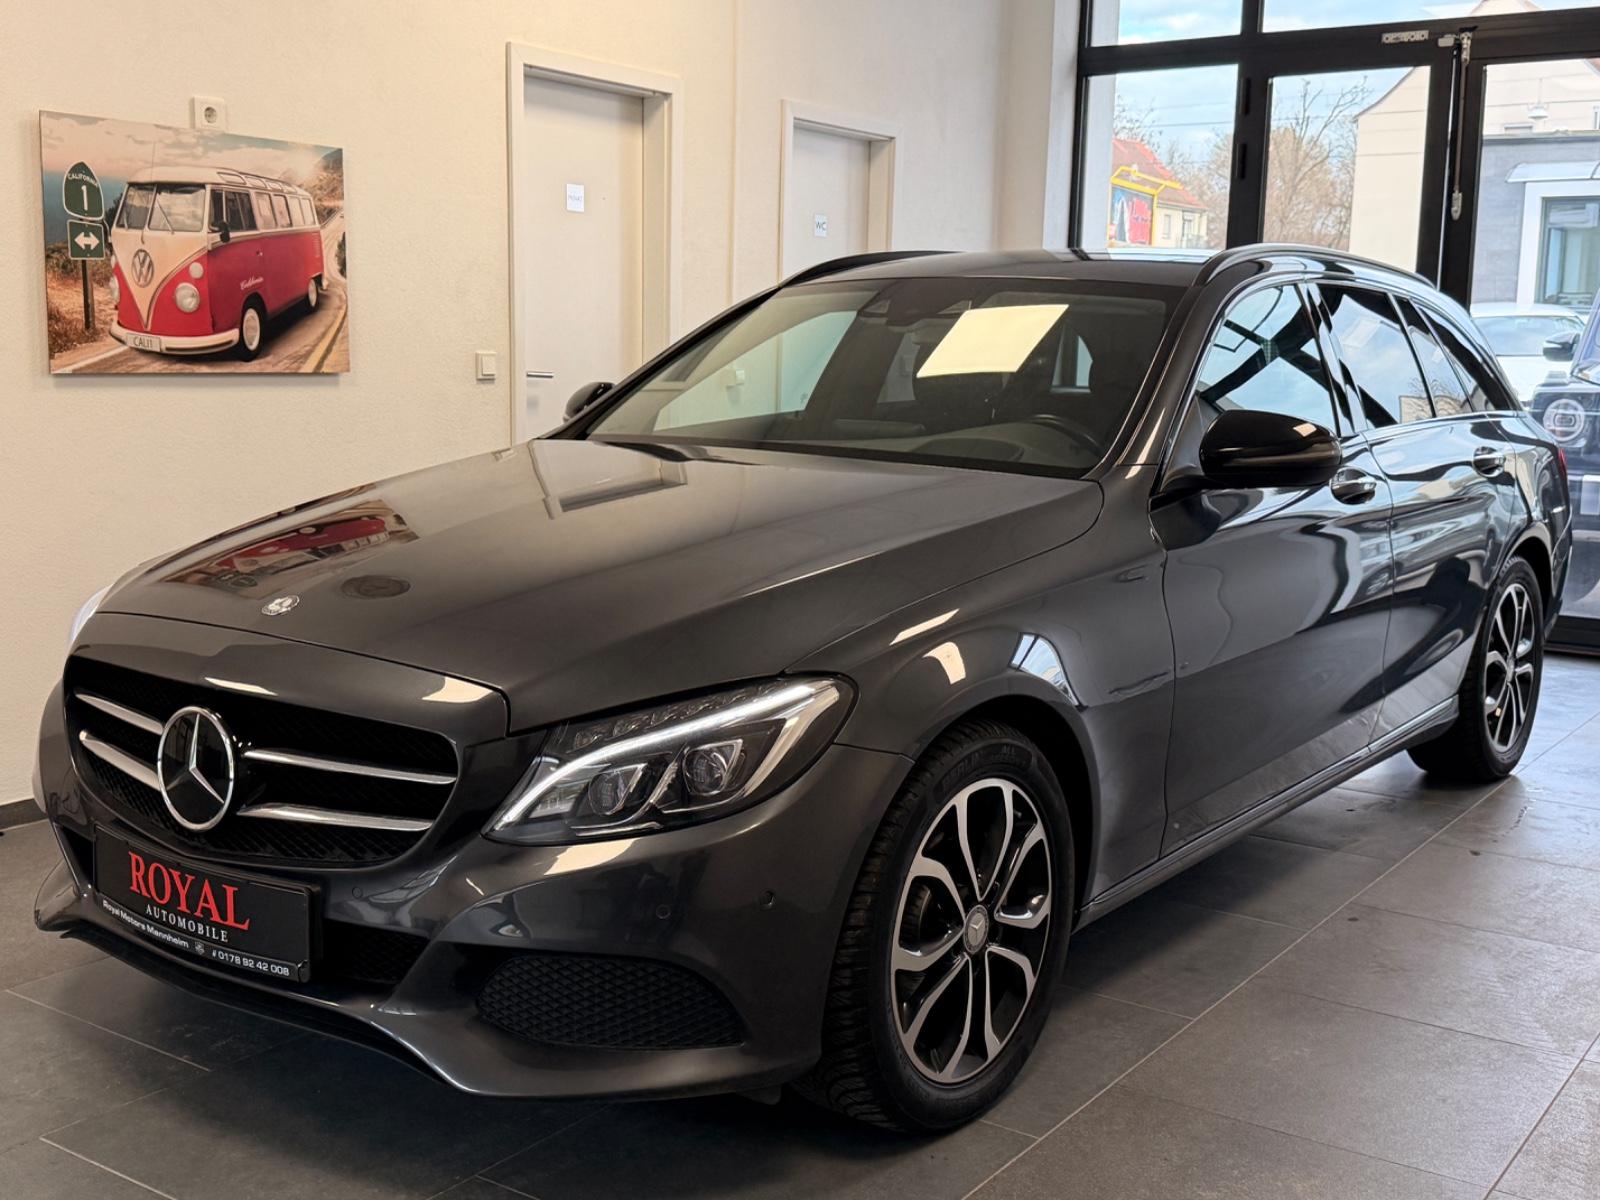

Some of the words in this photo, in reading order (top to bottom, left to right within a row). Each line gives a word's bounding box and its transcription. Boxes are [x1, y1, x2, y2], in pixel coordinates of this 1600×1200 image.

[81, 184, 88, 211] 1
[815, 221, 827, 231] WC
[128, 851, 250, 931] ROYAL
[102, 899, 120, 916] Royal
[120, 910, 145, 930] Motors
[146, 924, 189, 948] Mannheim
[256, 960, 269, 972] 42
[146, 904, 229, 943] AUTOMOBILE
